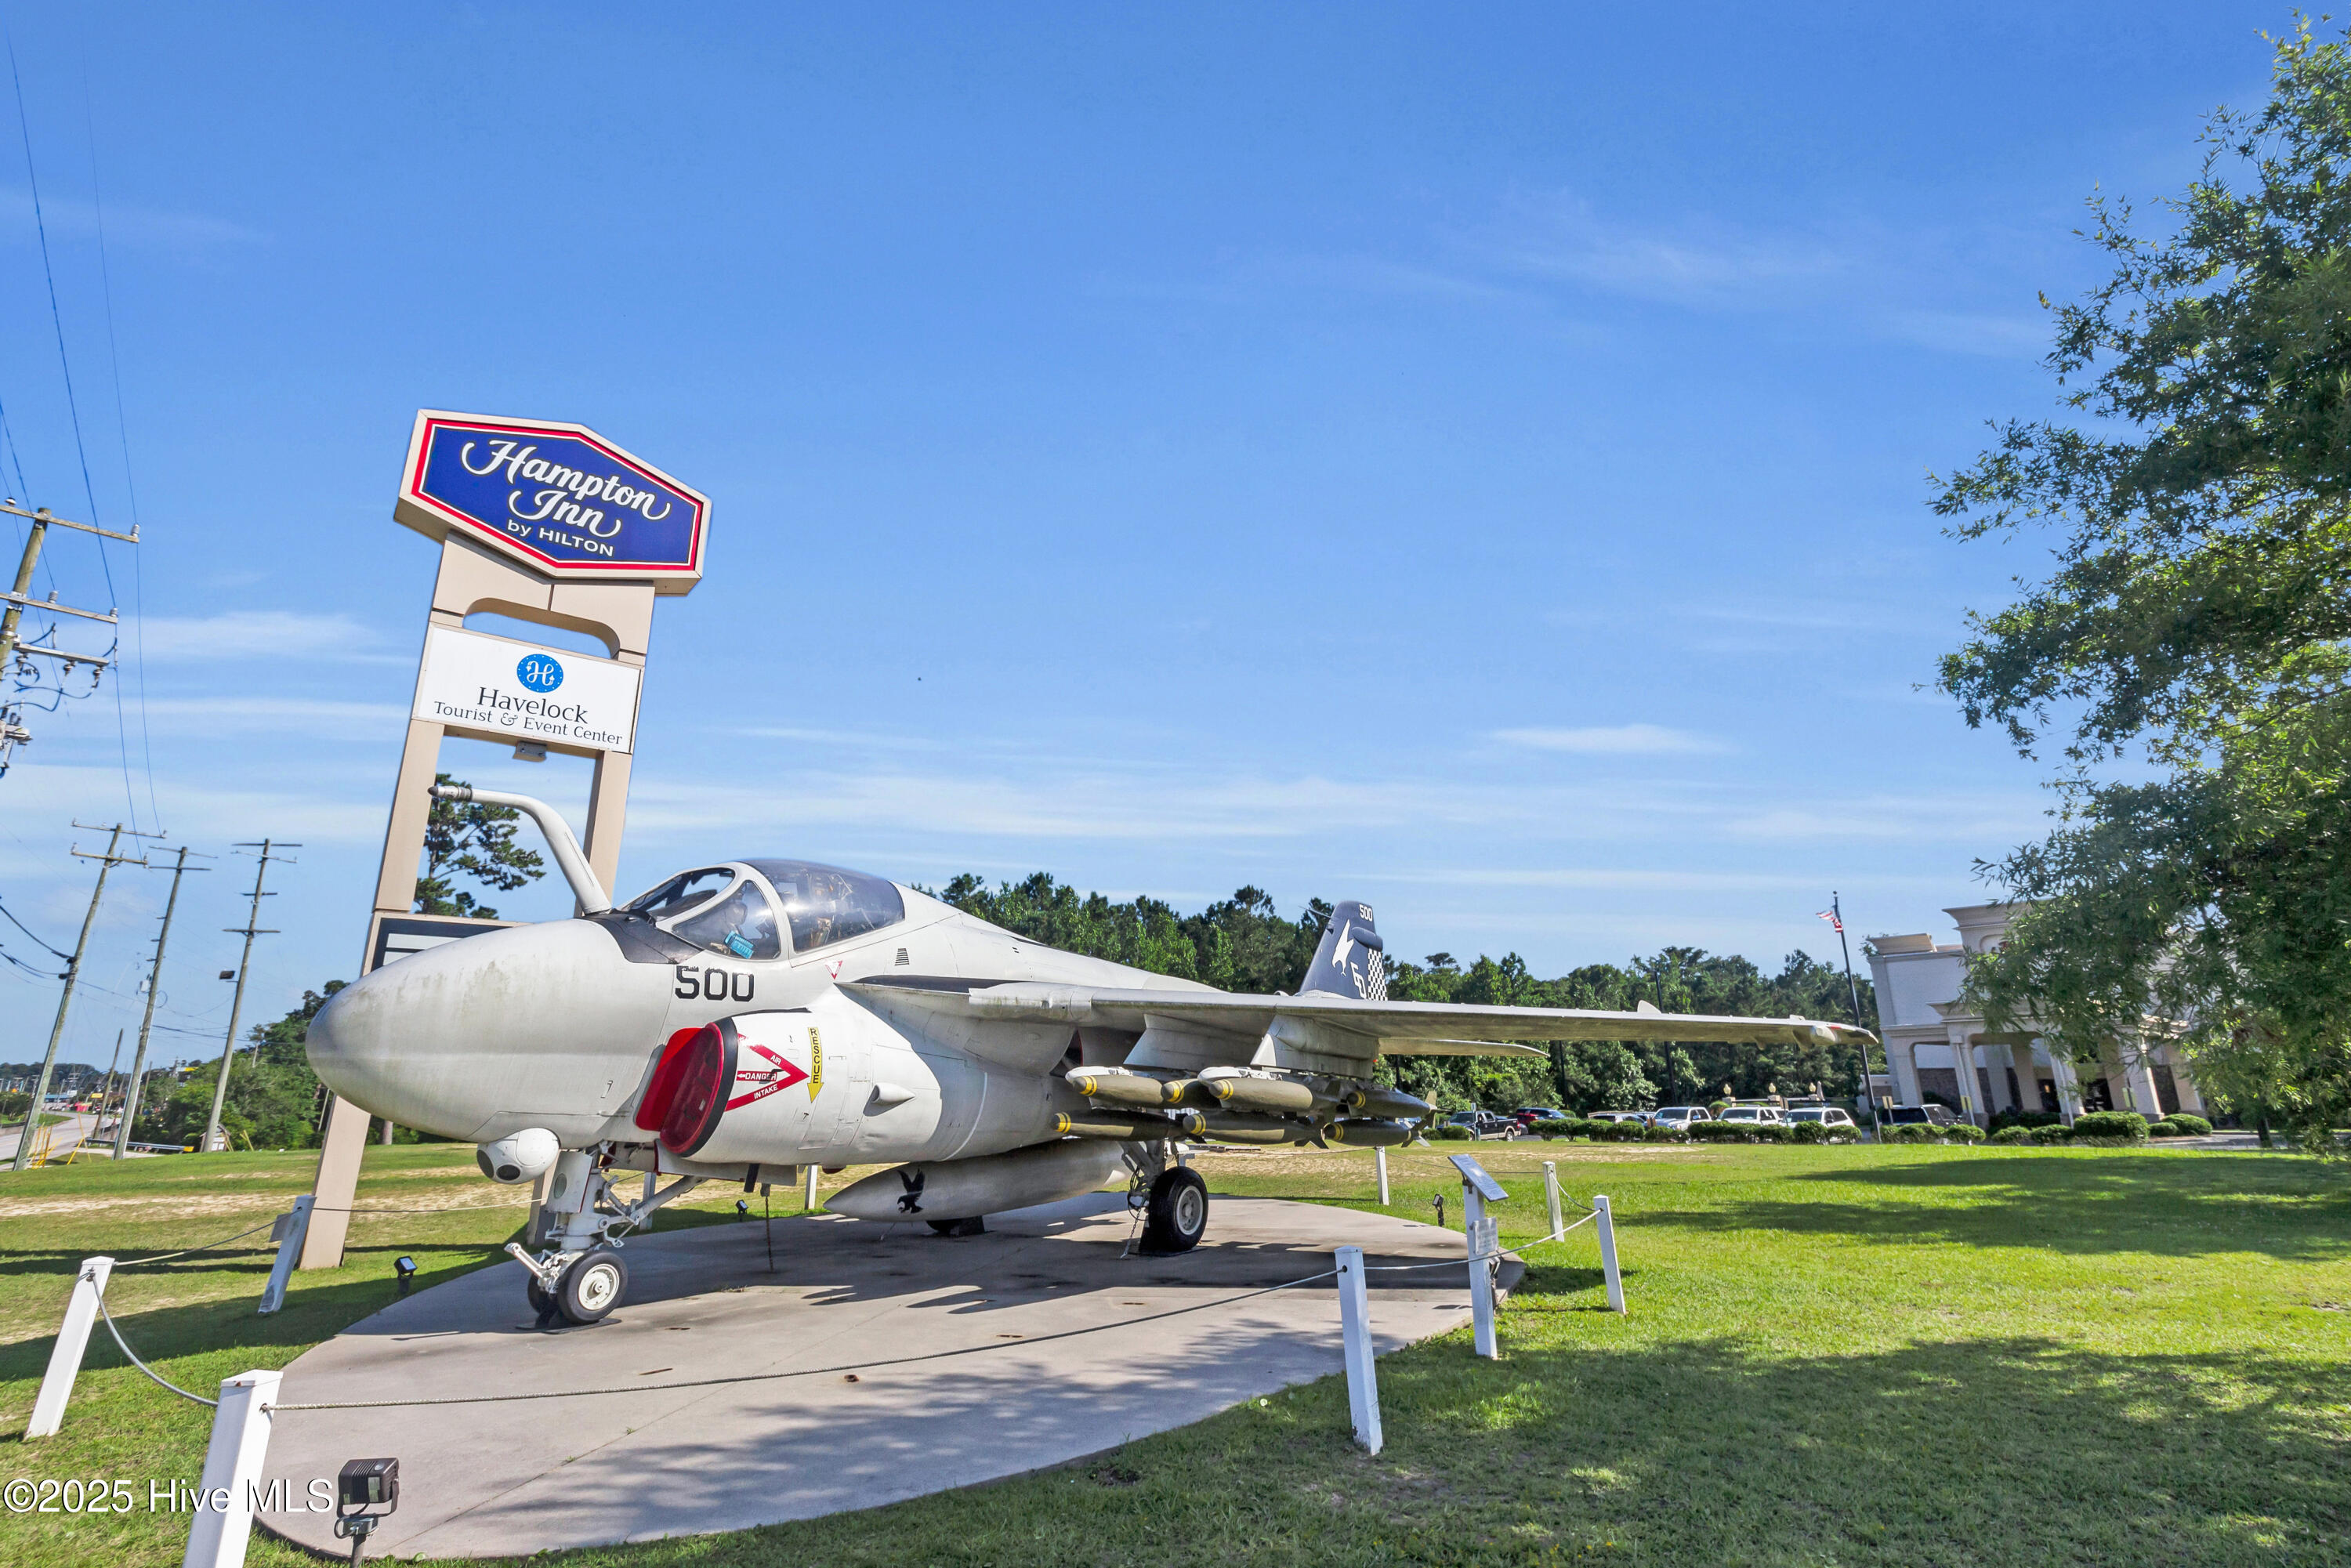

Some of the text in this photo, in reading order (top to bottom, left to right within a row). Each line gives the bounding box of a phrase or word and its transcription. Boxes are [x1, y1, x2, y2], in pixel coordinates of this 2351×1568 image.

[461, 440, 672, 520] Hampton
[509, 489, 622, 538] Inn
[508, 519, 614, 557] by HILTON
[434, 701, 622, 745] Tourist & Event Center
[477, 686, 588, 725] Havelock
[1359, 904, 1373, 922] 500
[675, 965, 754, 1002] 500
[770, 1056, 781, 1064] AIR
[810, 1028, 820, 1084] RESCUE
[754, 1085, 777, 1099] INTAKE
